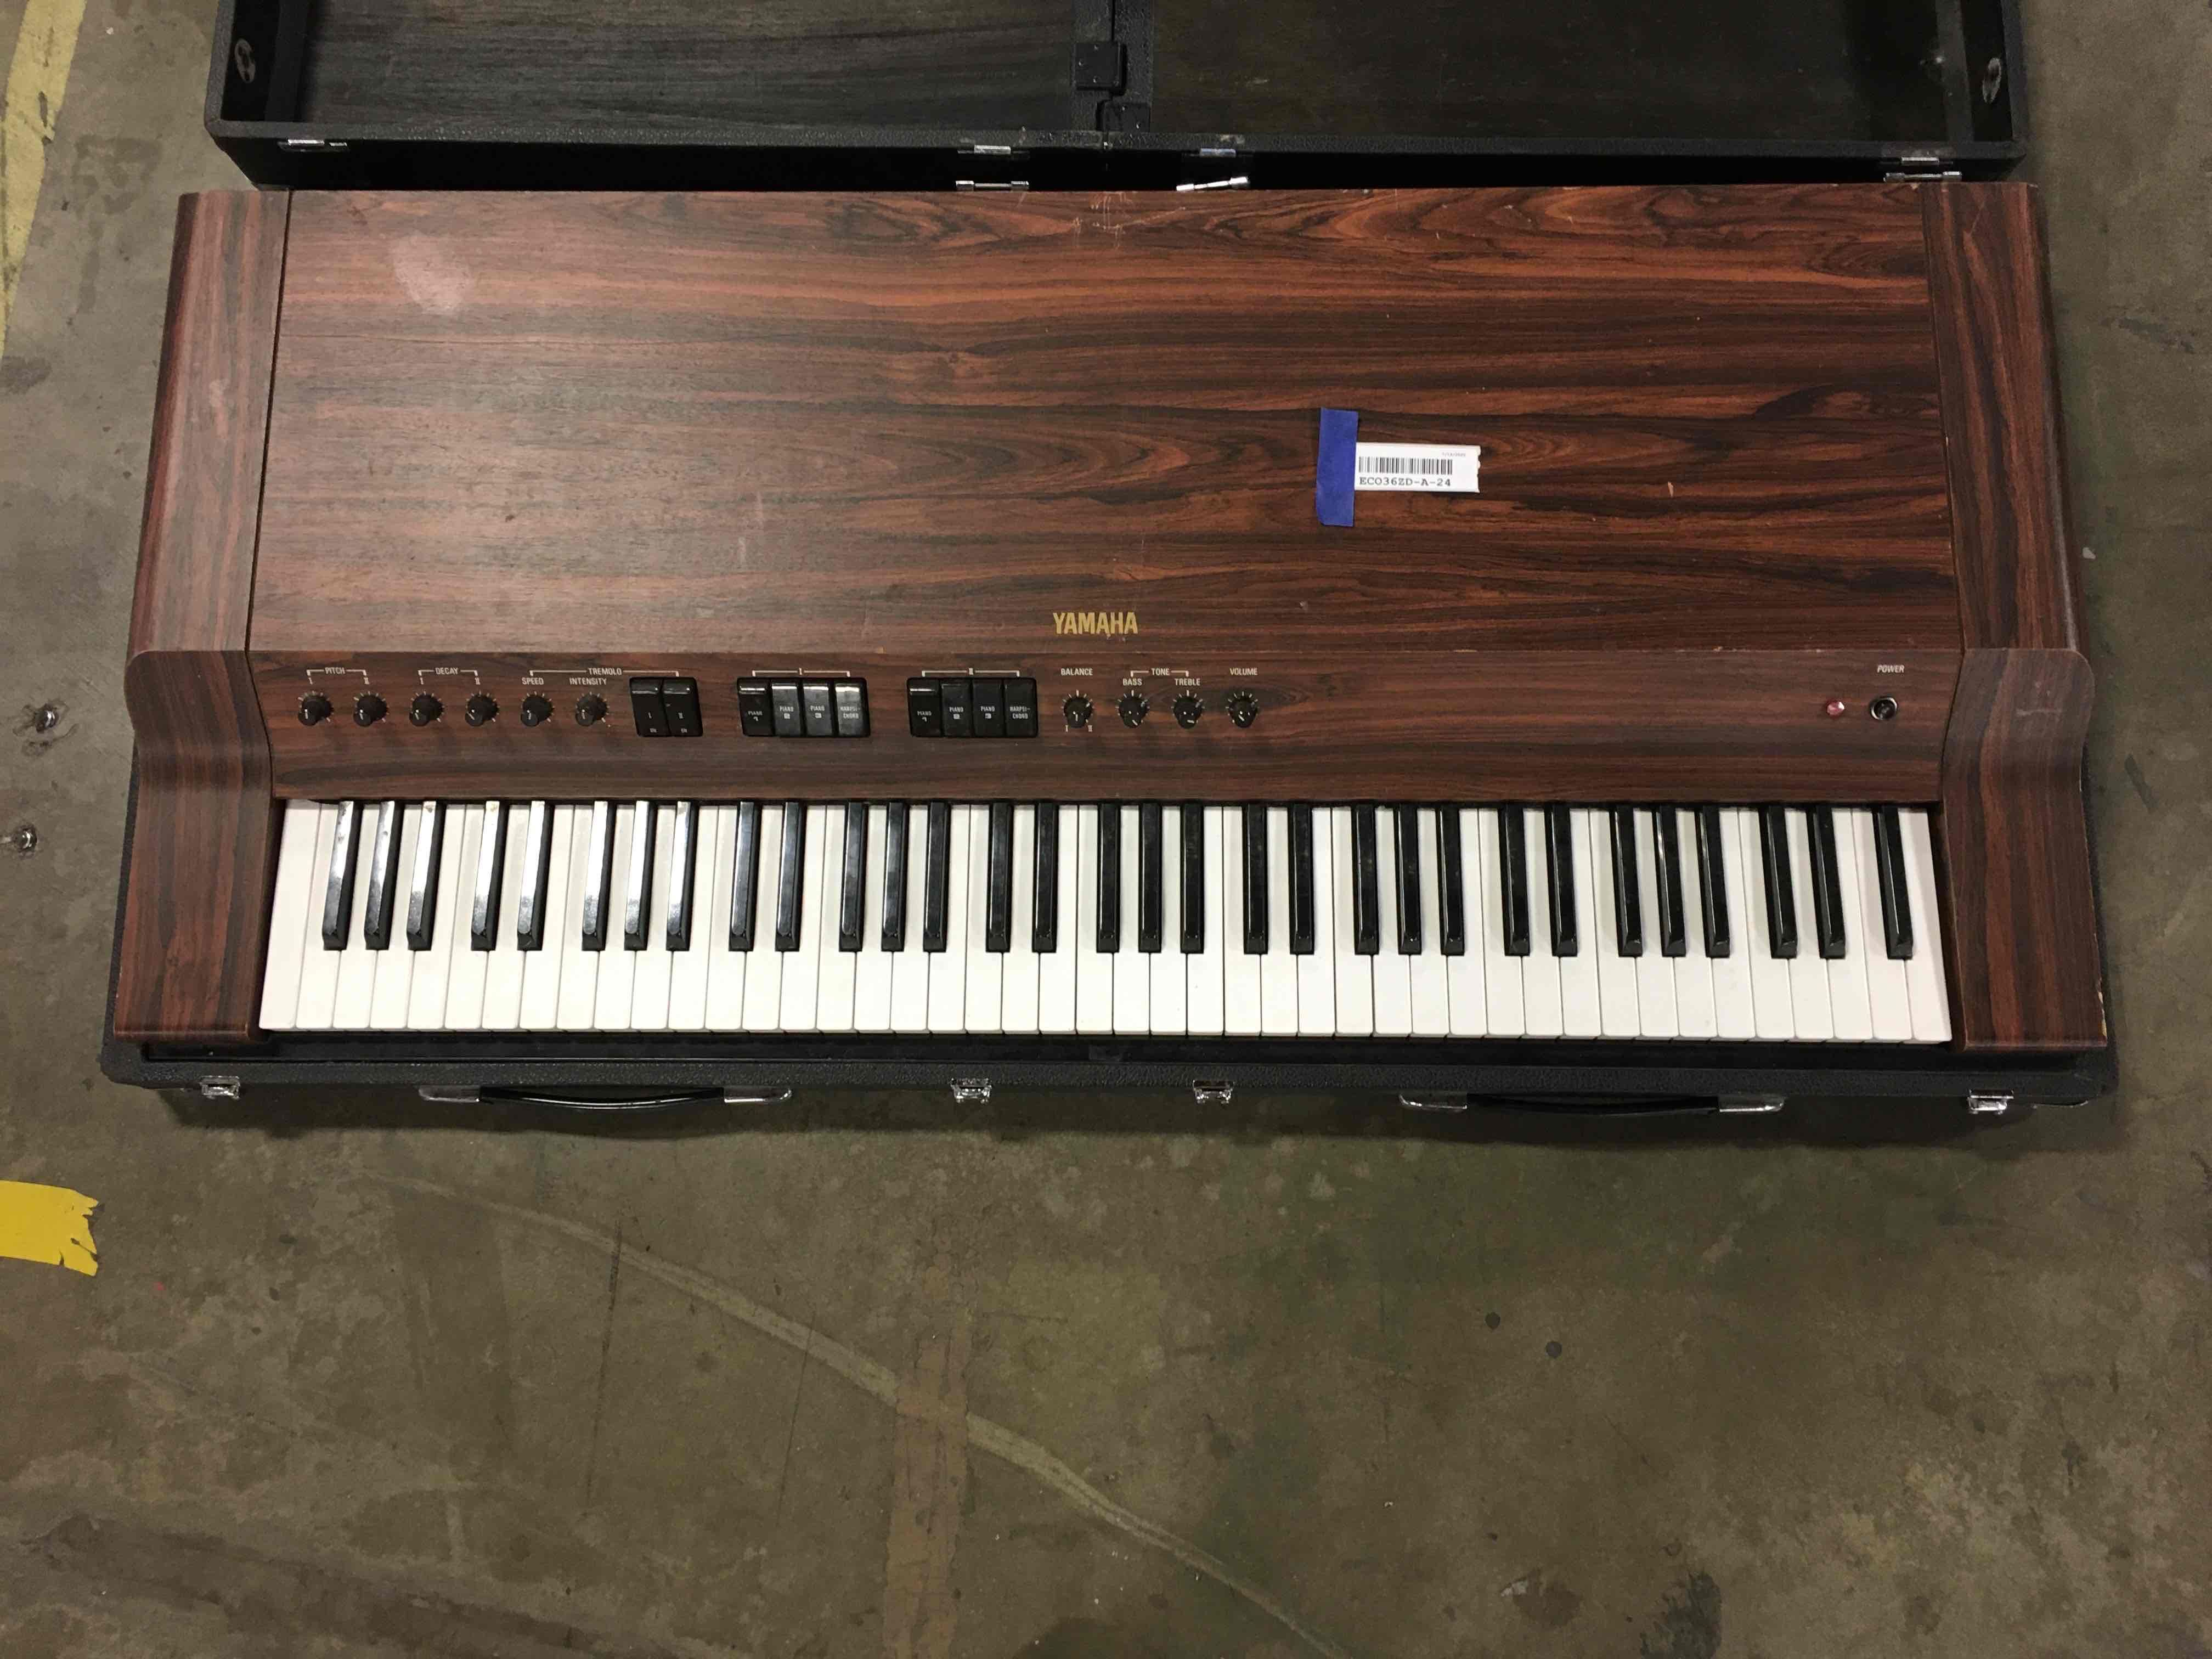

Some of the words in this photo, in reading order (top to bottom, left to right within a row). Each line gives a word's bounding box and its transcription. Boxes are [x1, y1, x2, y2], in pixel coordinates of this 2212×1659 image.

[1053, 612, 1138, 635] YAMAHA
[435, 667, 459, 675] DECAY
[588, 667, 622, 676] TREMOLO
[1060, 668, 1093, 676] BALANCE
[1152, 668, 1170, 676] TONE
[1229, 668, 1258, 676] VOLUME
[1877, 664, 1905, 673] POWER
[521, 677, 544, 685] SPEED
[569, 677, 607, 685] INTENSITY
[1122, 678, 1142, 686] BASS
[1174, 678, 1200, 686] TREBLE
